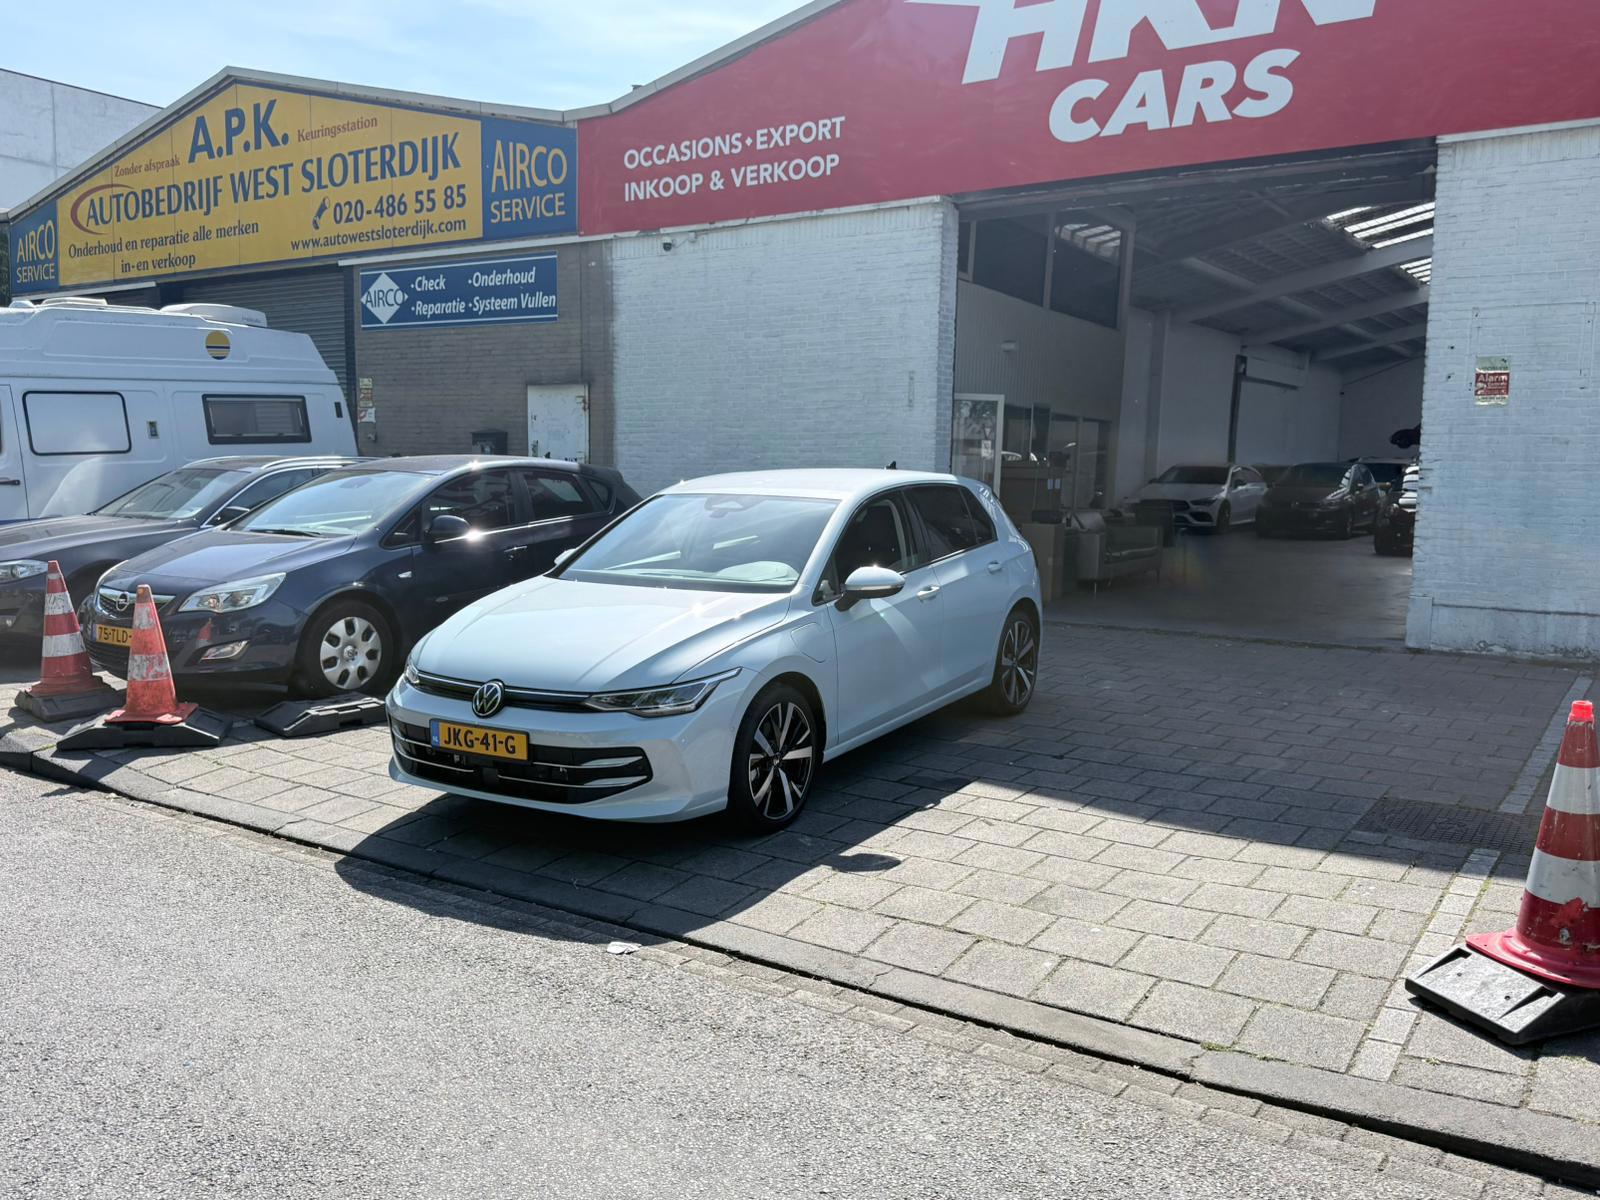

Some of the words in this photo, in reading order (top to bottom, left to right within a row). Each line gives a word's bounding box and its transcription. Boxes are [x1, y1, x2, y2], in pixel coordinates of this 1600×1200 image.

[1048, 48, 1301, 143] CARS
[188, 99, 289, 163] A.P.K.
[297, 116, 378, 142] Keuringsstation
[86, 175, 223, 227] AUTOBEDRIJF
[229, 163, 294, 204] WEST
[301, 132, 461, 193] SLOTERDIJK
[114, 163, 142, 178] Zonder
[144, 155, 181, 174] afspraak
[491, 140, 567, 192] AIRCO
[624, 172, 704, 202] INKOOP
[709, 170, 725, 191] &
[730, 153, 840, 187] VERKOOP
[333, 193, 408, 224] 020-486
[414, 189, 436, 214] 55
[443, 184, 467, 210] 85
[491, 192, 566, 223] SERVICE
[17, 219, 56, 263] AIRCO
[68, 238, 123, 259] Onderhoud
[125, 240, 138, 251] en
[141, 230, 189, 254] reparatie
[192, 225, 213, 242] alle
[216, 219, 259, 239] merken
[291, 219, 467, 250] www.autowestsloterdijk.com
[17, 263, 55, 283] SERVICE
[152, 252, 196, 270] verkoop
[415, 274, 446, 291] Check
[473, 266, 536, 287] Onderhoud
[364, 288, 405, 308] AIRCO
[415, 298, 466, 319] Reparatie
[473, 296, 518, 316] Systeem
[520, 292, 557, 309] Vullen
[1477, 374, 1508, 382] Alarm
[99, 626, 132, 643] 75-TLD-
[443, 726, 517, 755] JKG-41-G
